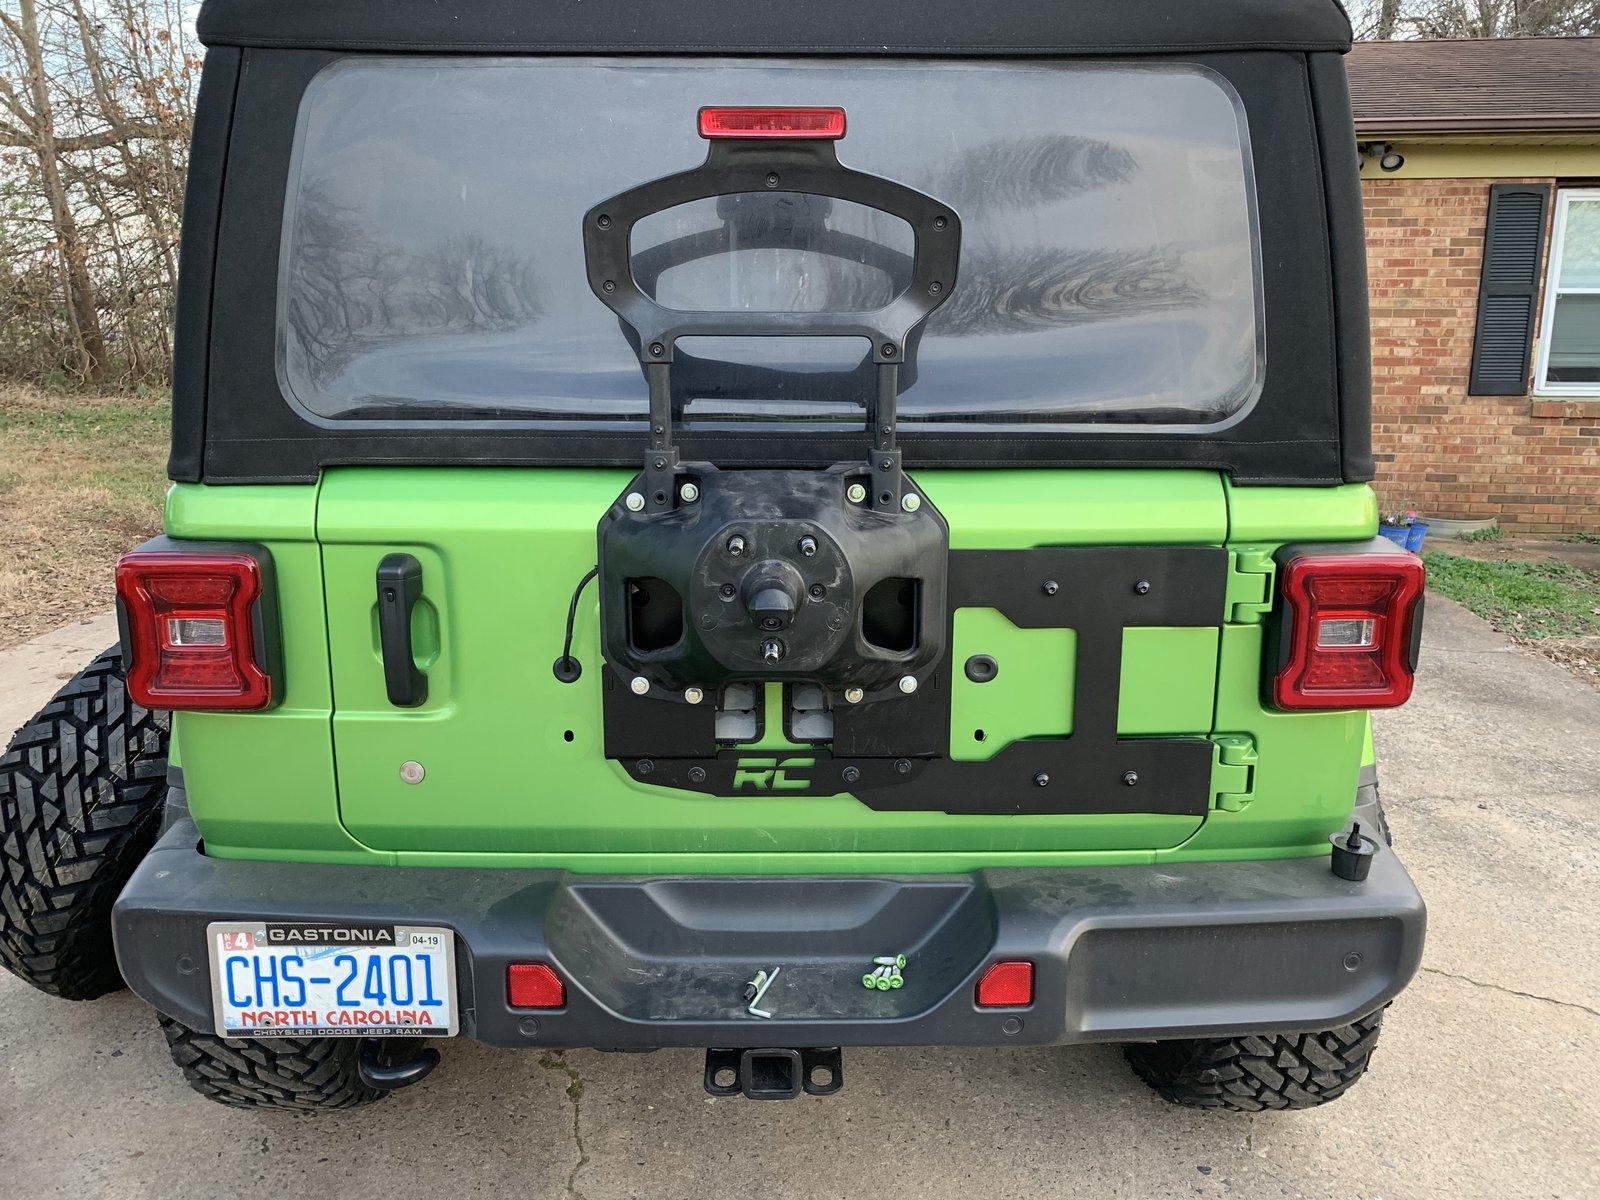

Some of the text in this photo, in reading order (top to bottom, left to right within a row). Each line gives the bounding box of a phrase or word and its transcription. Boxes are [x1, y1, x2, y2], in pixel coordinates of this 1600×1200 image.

[733, 758, 815, 789] RC
[234, 932, 249, 949] 4
[269, 929, 392, 941] GASTONIA
[412, 936, 439, 945] 04-19
[226, 954, 443, 1008] CHS-2401
[241, 1010, 433, 1026] NORTH CAROLINA
